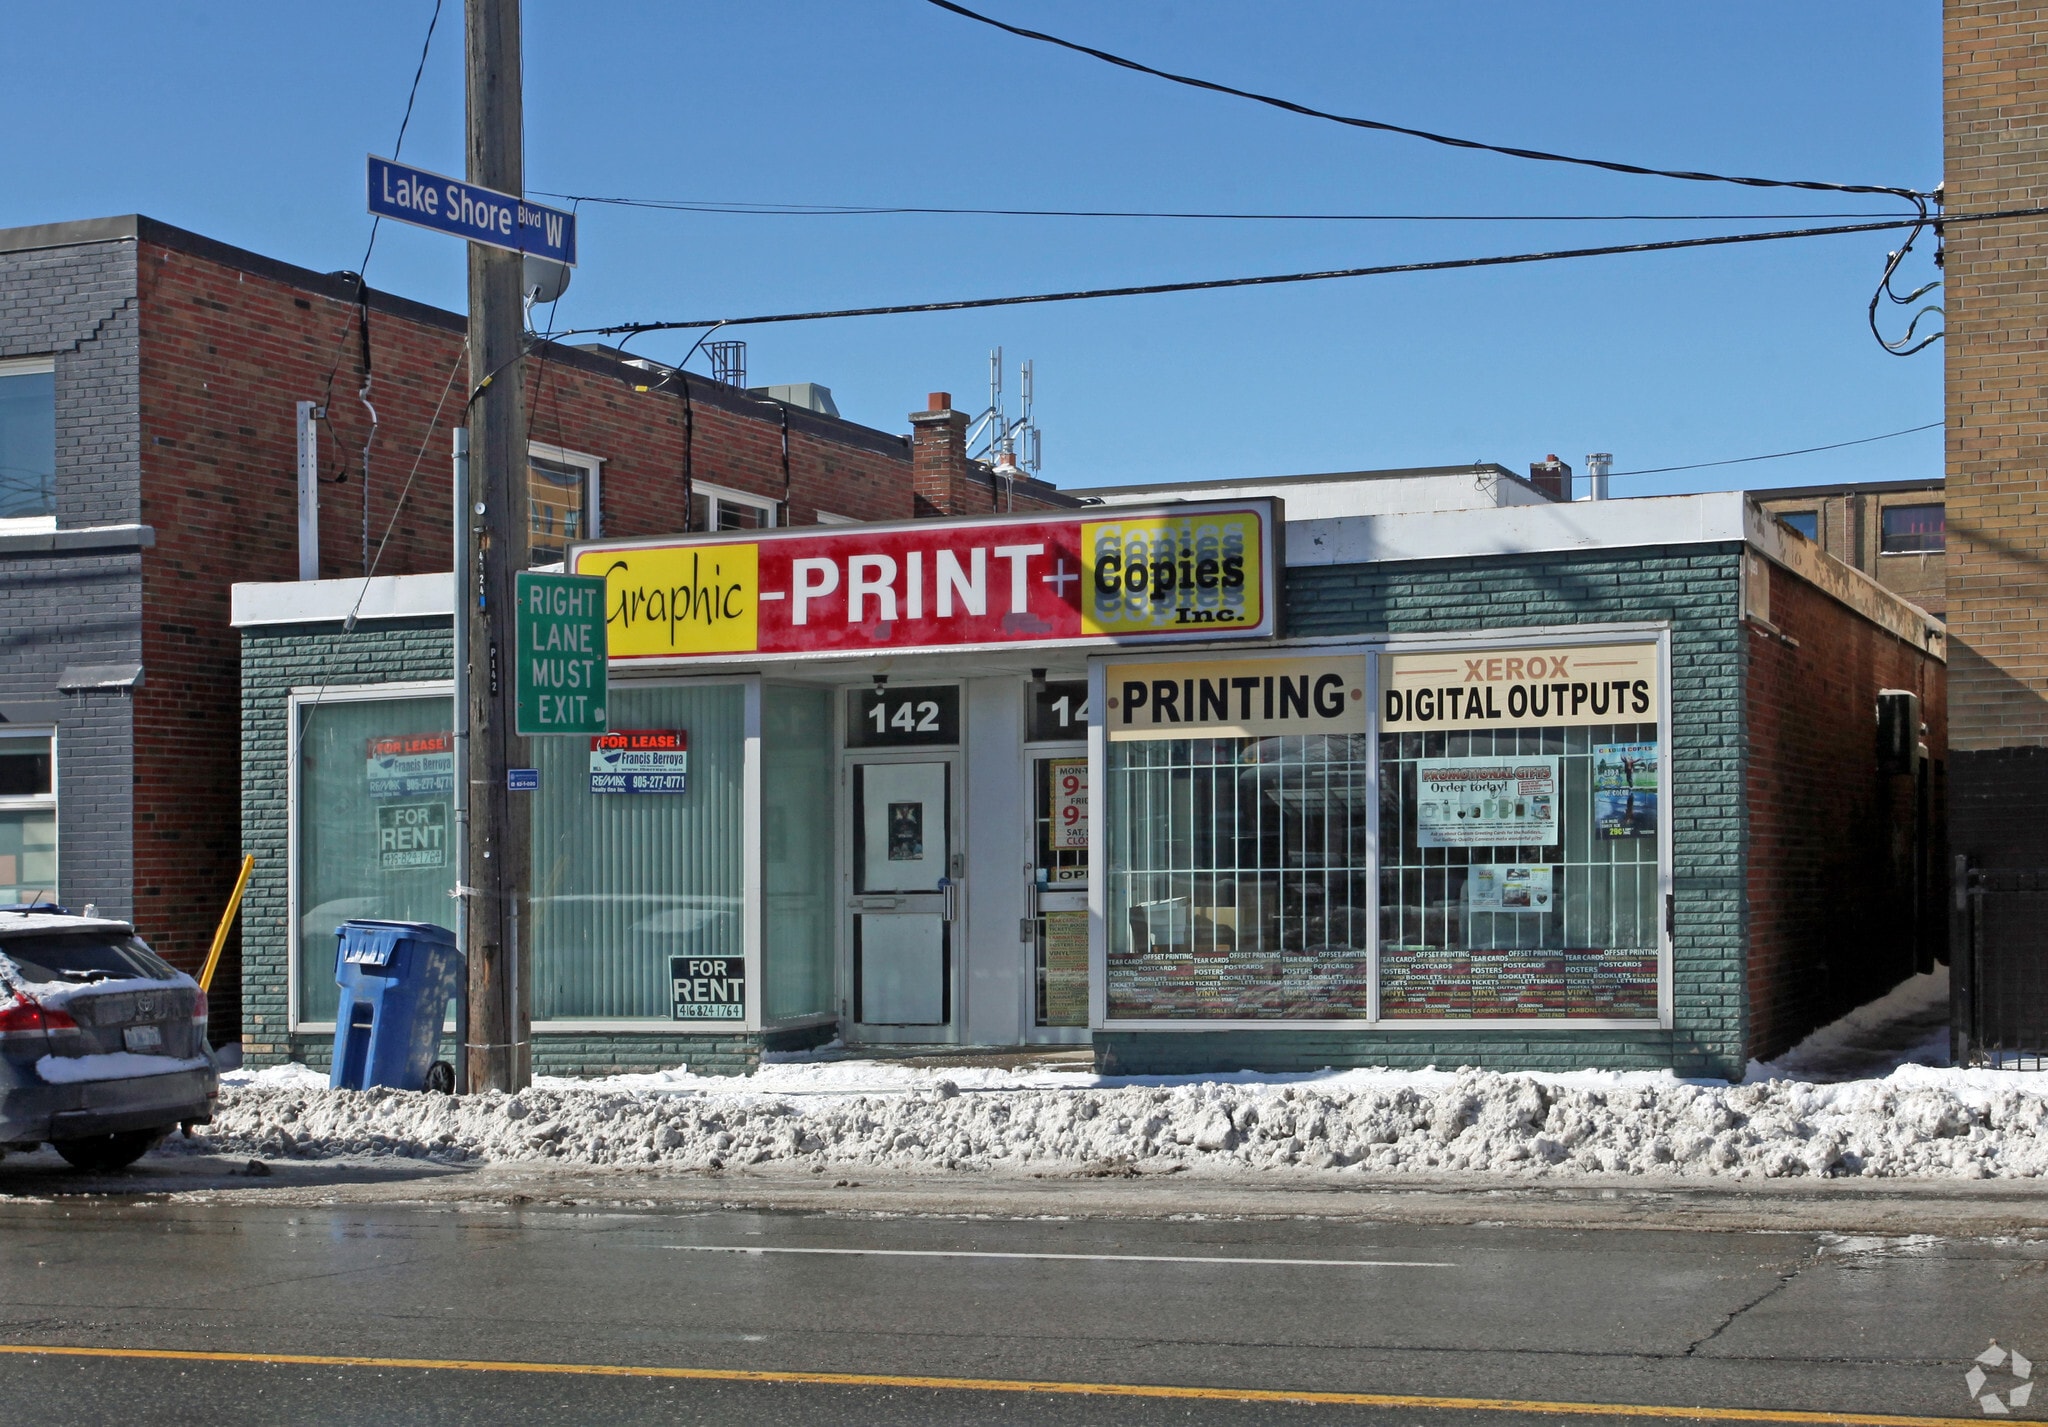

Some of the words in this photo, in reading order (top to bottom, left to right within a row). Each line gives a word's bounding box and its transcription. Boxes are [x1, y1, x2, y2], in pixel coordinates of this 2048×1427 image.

[383, 166, 439, 215] Lake
[446, 185, 512, 234] Shore
[518, 205, 541, 228] Blvd
[545, 212, 563, 248] W
[530, 585, 596, 617] RIGHT
[606, 552, 743, 646] Graphic
[1094, 548, 1244, 600] Copies
[1175, 607, 1244, 624] Inc.
[533, 622, 593, 653] LANE
[533, 658, 594, 688] MUST
[1464, 655, 1569, 682] XEROX
[539, 695, 587, 724] EXIT
[1123, 673, 1345, 724] PRINTING
[1385, 686, 1501, 722] DIGITAL
[1508, 680, 1650, 718] OUTPUTS
[868, 701, 939, 733] 142
[376, 741, 401, 755] FOR
[405, 738, 444, 752] LEASE
[601, 736, 628, 748] FOR
[632, 736, 675, 748] LEASE
[394, 759, 421, 773] Francis
[423, 758, 451, 771] Berroya
[621, 752, 651, 765] Francis
[653, 752, 683, 766] Berroya
[633, 775, 685, 789] 905-277-0771
[1422, 766, 1514, 782] PROMOTIONAL
[1515, 765, 1551, 780] GIFTS
[1431, 782, 1467, 793] Order
[1470, 781, 1508, 797] today!
[395, 808, 429, 825] FOR
[381, 825, 444, 850] RENT
[1059, 870, 1088, 880] OP
[689, 960, 727, 976] FOR
[673, 978, 744, 1002] RENT
